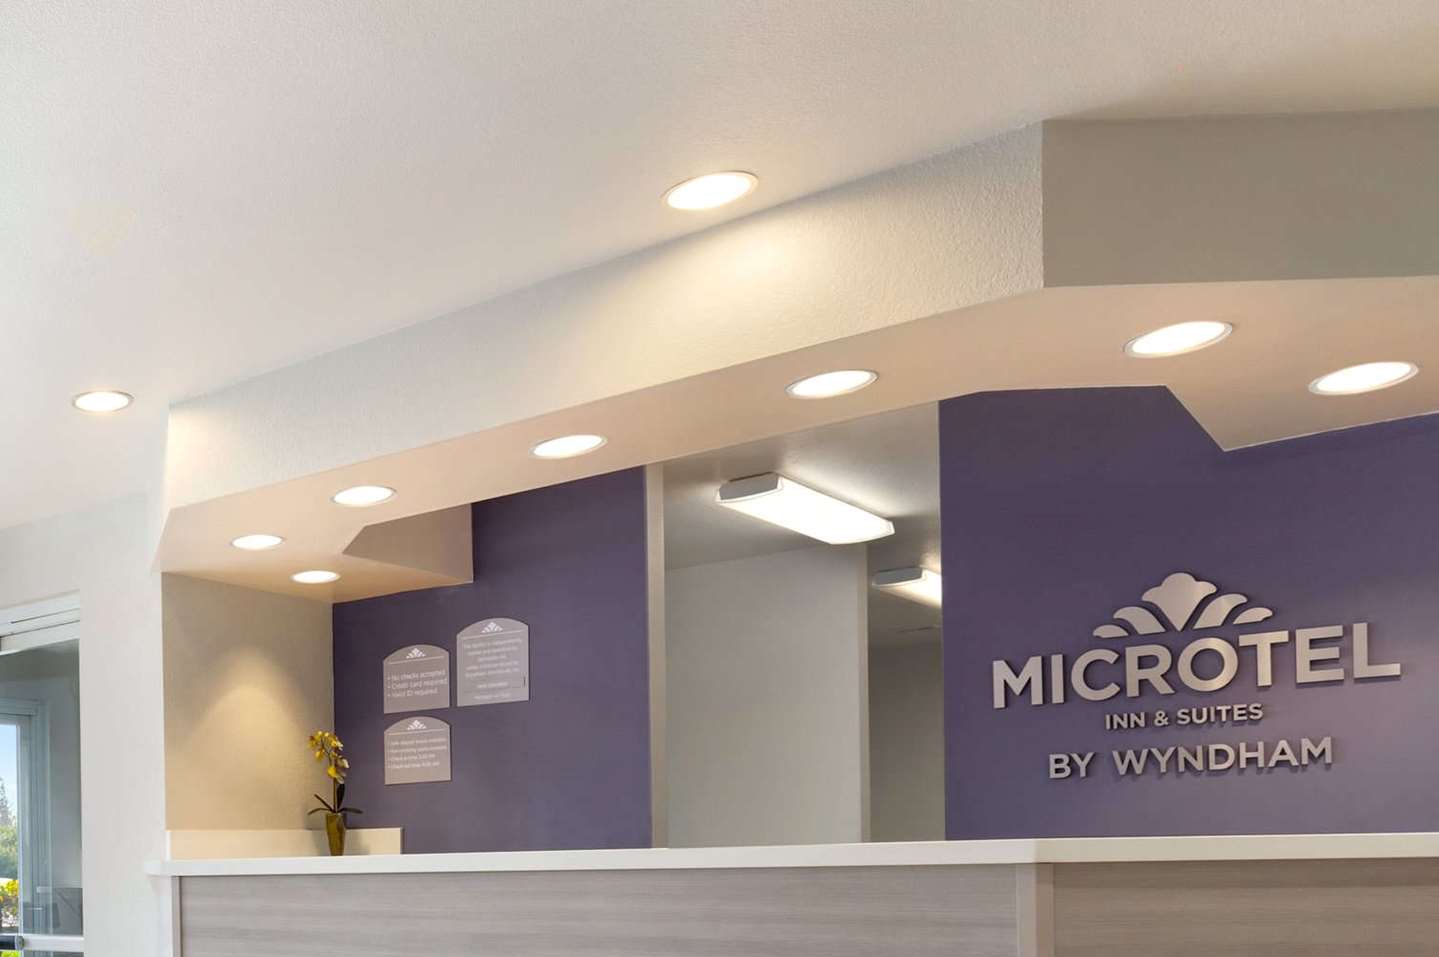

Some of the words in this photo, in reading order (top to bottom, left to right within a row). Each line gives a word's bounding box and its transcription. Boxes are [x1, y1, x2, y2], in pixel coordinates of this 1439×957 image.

[992, 622, 1402, 709] MICROTEL
[1105, 711, 1146, 730] INN
[1154, 711, 1169, 727] &
[1177, 703, 1264, 726] SUITES
[1049, 751, 1096, 779] BY
[1112, 736, 1333, 776] WYNDHAM
